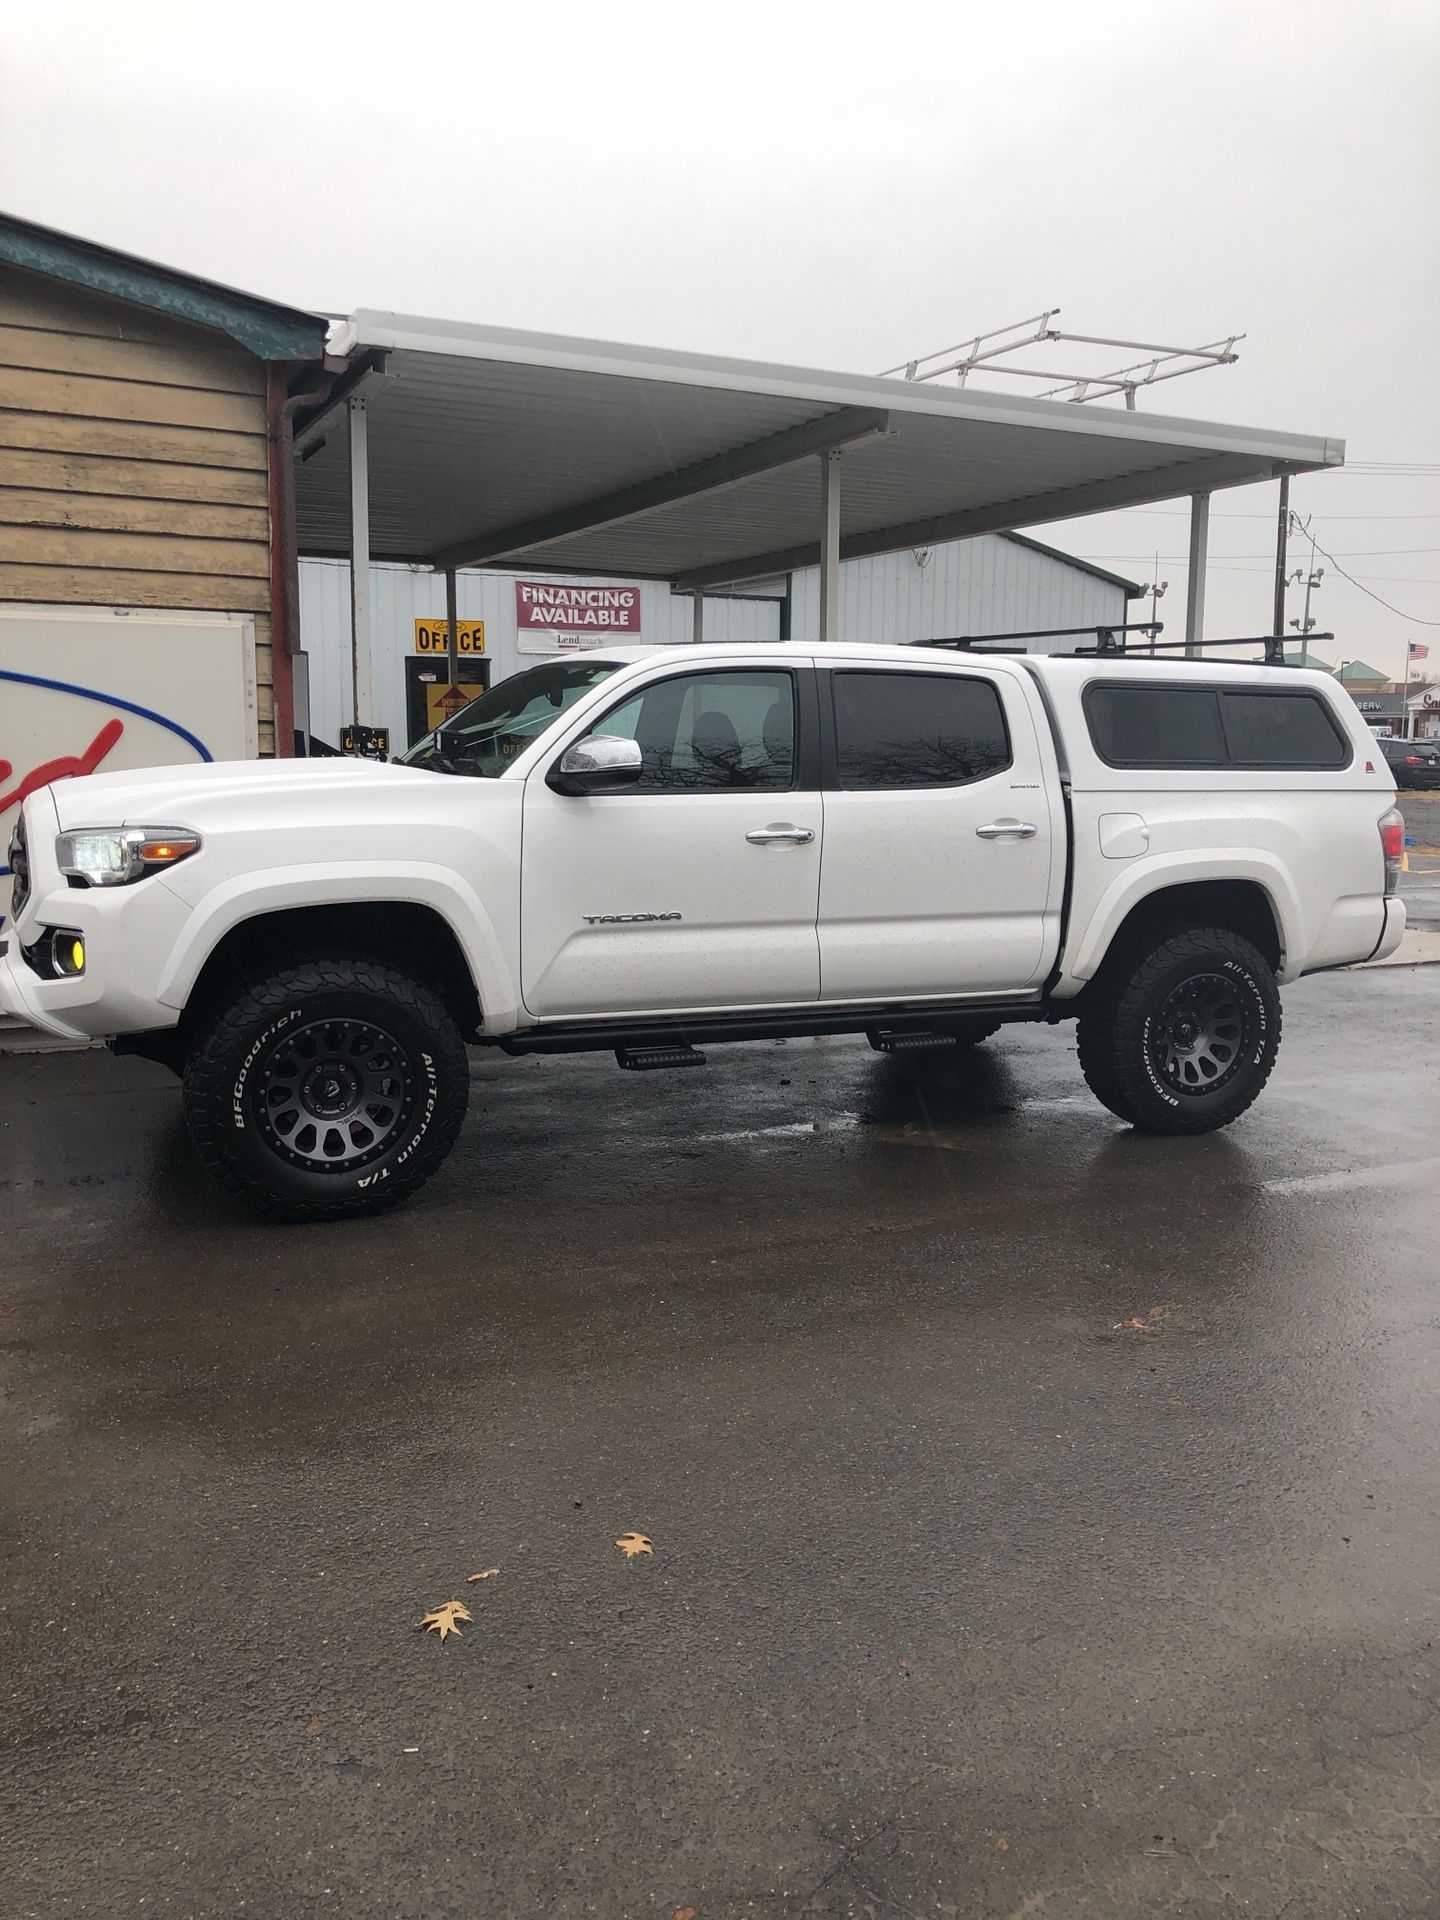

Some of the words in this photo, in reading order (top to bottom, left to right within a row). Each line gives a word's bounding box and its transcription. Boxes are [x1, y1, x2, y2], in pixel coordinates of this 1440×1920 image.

[522, 586, 634, 607] FINANCING
[530, 607, 629, 625] AVAILABLE
[418, 626, 482, 651] OFFCE
[557, 635, 604, 645] Lendmark
[582, 910, 682, 924] TACOMA
[1223, 961, 1266, 1031] All-Terrain
[233, 1008, 302, 1129] BFGoodrich
[1143, 1016, 1180, 1107] BFGoodrich
[397, 1052, 438, 1164] All-Terrain
[357, 1167, 391, 1188] T/A
